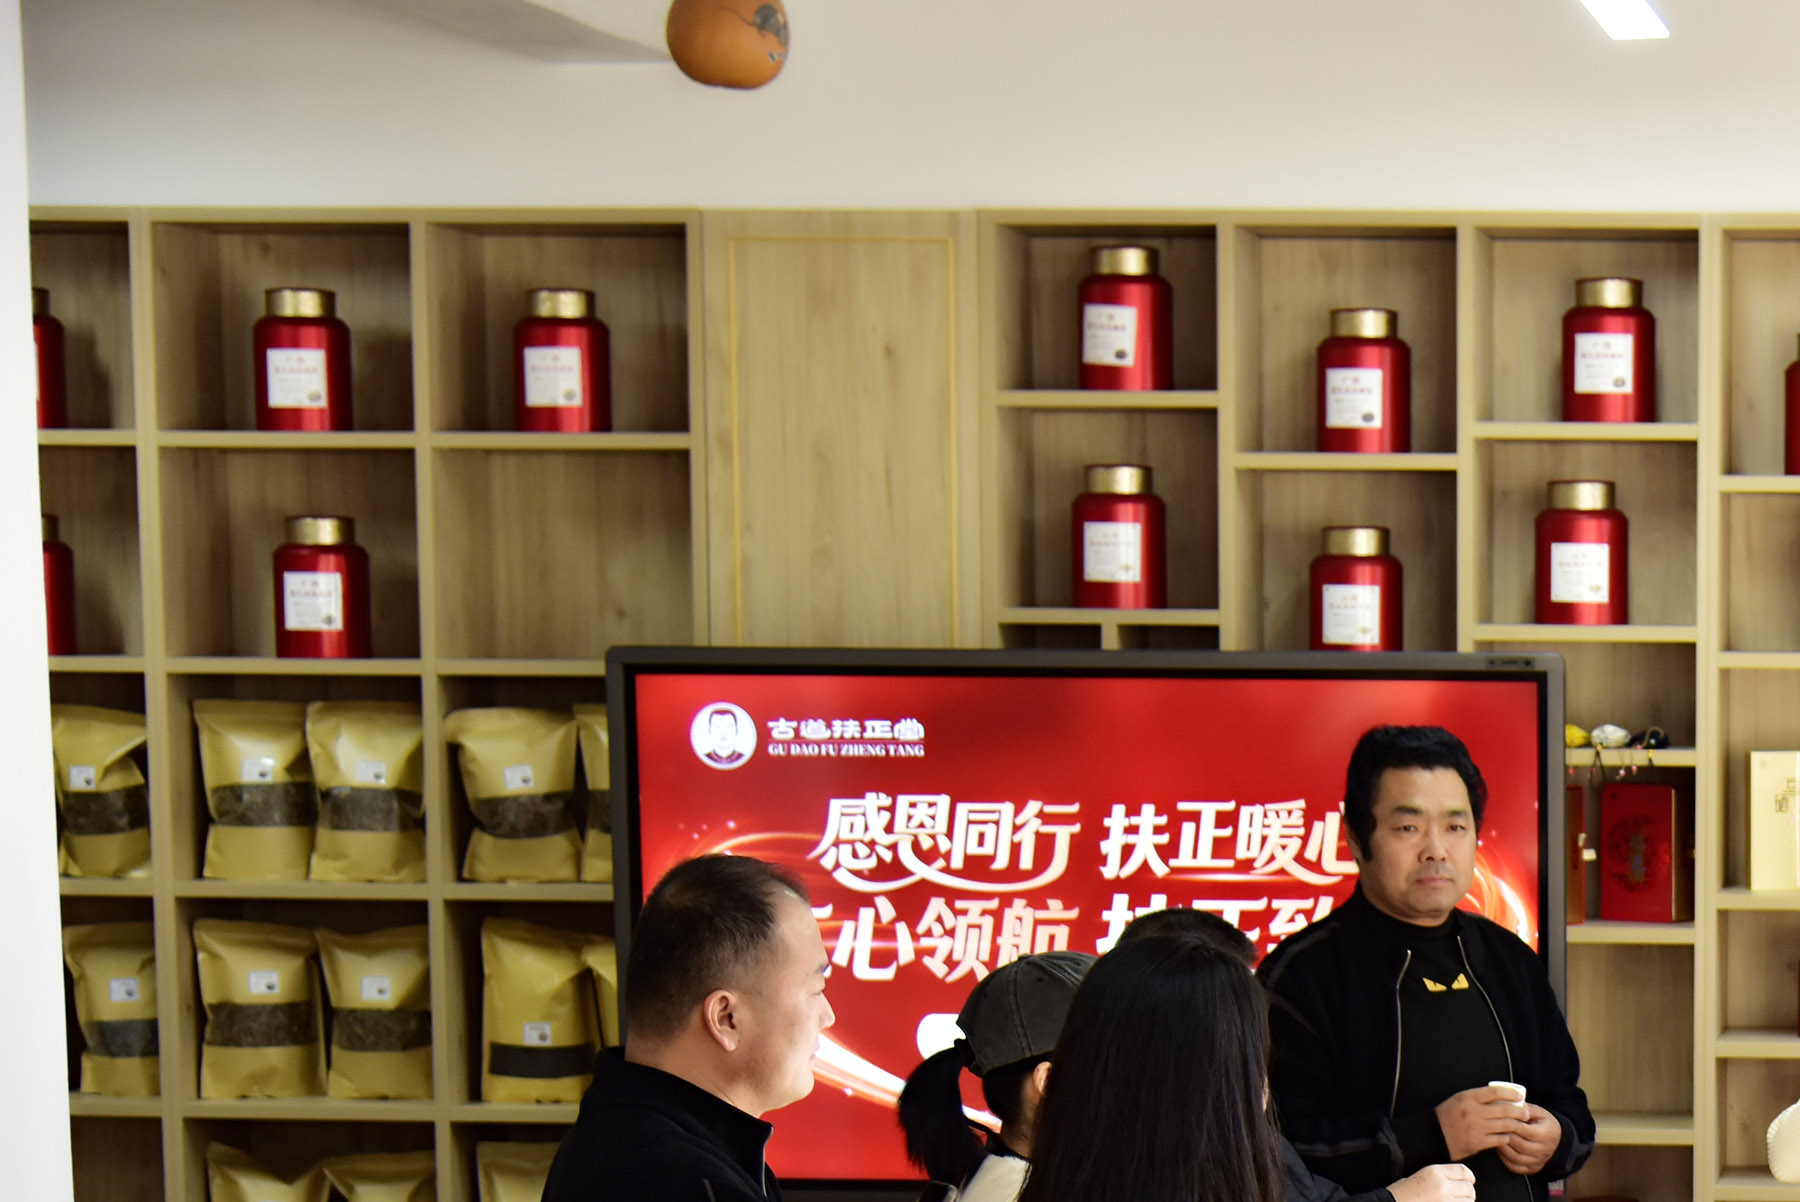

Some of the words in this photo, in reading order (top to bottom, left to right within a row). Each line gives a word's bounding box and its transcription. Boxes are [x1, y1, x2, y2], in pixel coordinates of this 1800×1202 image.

[767, 743, 788, 757] GU
[790, 743, 819, 757] DAO
[820, 743, 839, 757] FU
[840, 743, 886, 757] ZHENG
[888, 743, 925, 757] TANG
[807, 792, 1081, 892] 感恩同行
[811, 895, 1080, 983] 心领航
